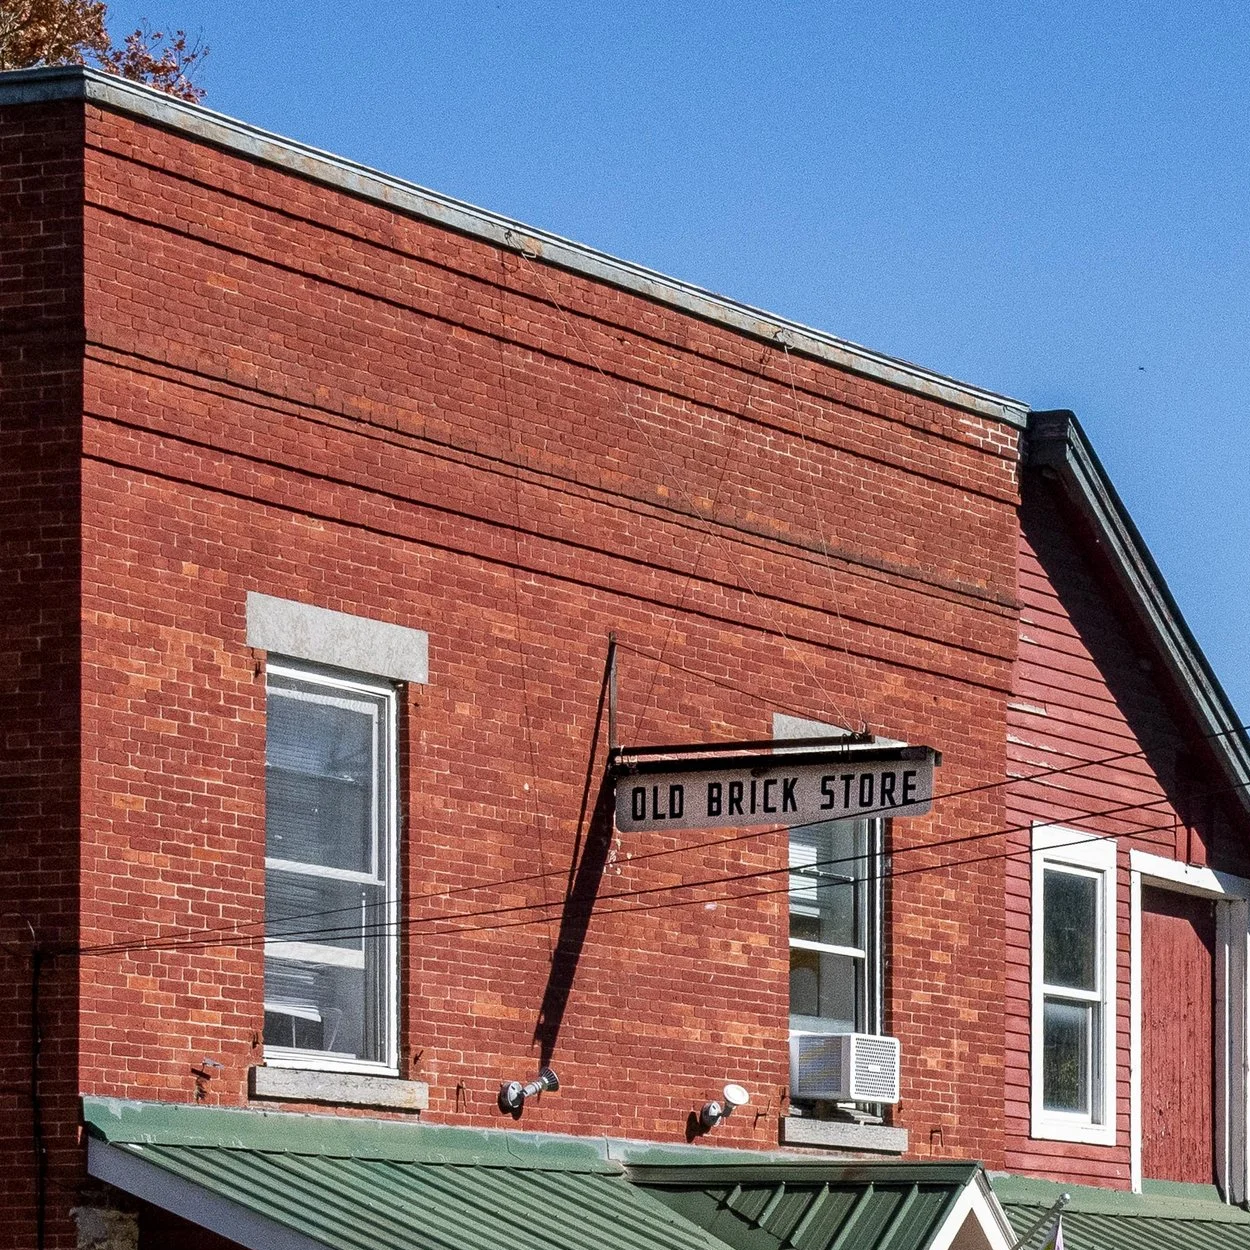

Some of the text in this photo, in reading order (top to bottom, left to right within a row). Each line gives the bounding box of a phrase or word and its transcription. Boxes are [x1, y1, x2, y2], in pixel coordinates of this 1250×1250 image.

[631, 770, 917, 821] OLD BRICK STORE
